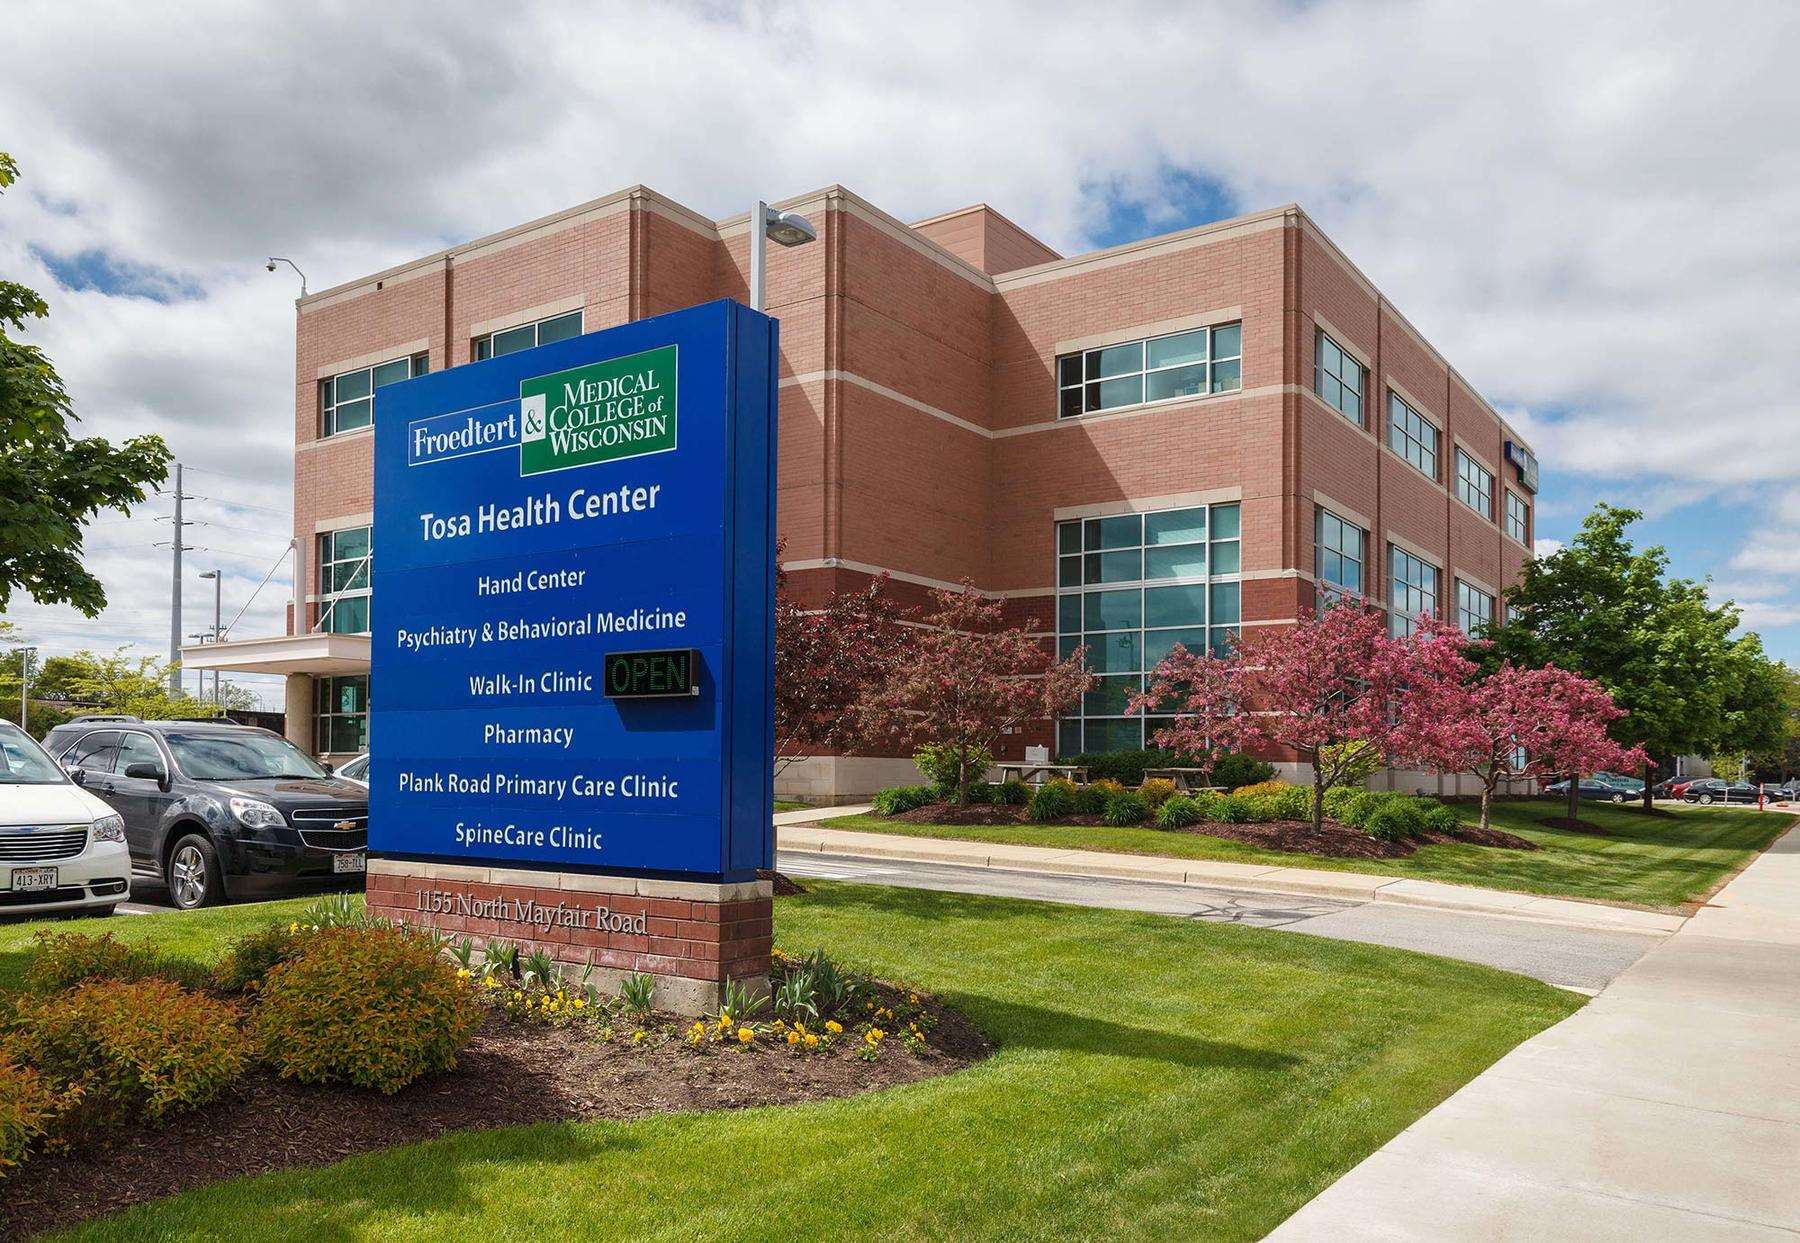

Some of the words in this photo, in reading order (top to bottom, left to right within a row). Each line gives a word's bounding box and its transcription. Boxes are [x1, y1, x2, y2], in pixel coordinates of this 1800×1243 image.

[563, 369, 660, 408] MEDICAL
[549, 395, 645, 431] COLLEGE
[648, 395, 665, 413] of
[414, 414, 518, 457] Froedtert
[525, 409, 544, 435] &
[549, 415, 668, 456] WISCONSIN
[420, 513, 471, 541] Tosa
[478, 493, 561, 533] Health
[568, 484, 661, 520] Center
[478, 572, 523, 596] Hand
[527, 569, 586, 591] Center
[397, 626, 477, 652] Psychiatry
[481, 622, 494, 642] &
[498, 613, 591, 641] Behavioral
[597, 607, 687, 634] Medicine
[470, 674, 536, 696] Walk-In
[540, 670, 593, 694] Clinic
[611, 655, 686, 692] OPEN
[484, 724, 574, 749] Pharmacy
[399, 773, 444, 793] Plank
[448, 773, 491, 794] Road
[496, 774, 567, 800] Primary
[571, 775, 615, 797] Care
[620, 775, 679, 798] Clinic
[455, 822, 544, 848] SpineCare
[550, 826, 602, 850] Clinic
[16, 873, 54, 887] 413-XRY
[415, 889, 453, 914] 1155
[456, 893, 511, 921] North
[514, 898, 592, 933] Mayfair
[595, 906, 649, 936] Road
